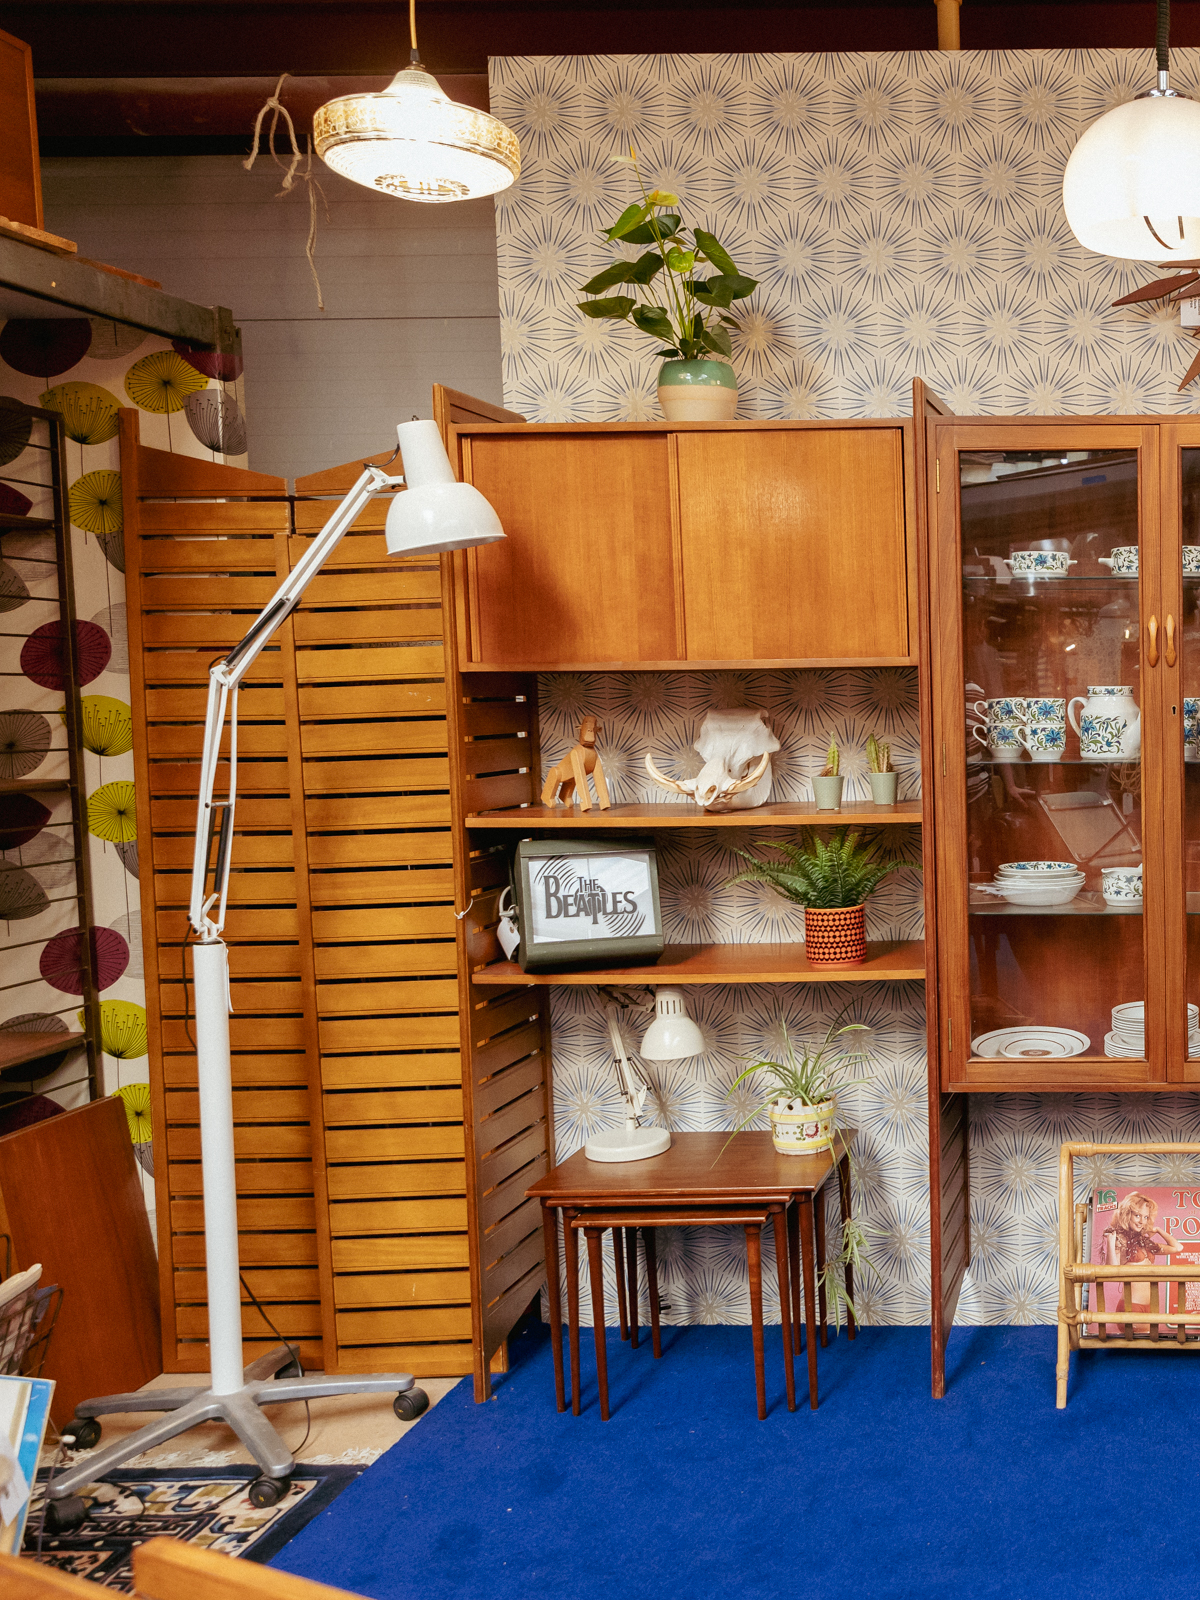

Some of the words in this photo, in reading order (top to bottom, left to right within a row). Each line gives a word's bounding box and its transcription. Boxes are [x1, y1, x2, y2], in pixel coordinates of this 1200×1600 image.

[577, 876, 600, 893] THE
[543, 875, 638, 925] BEATLES
[1097, 1189, 1117, 1204] 16
[1097, 1203, 1117, 1212] TRACKS
